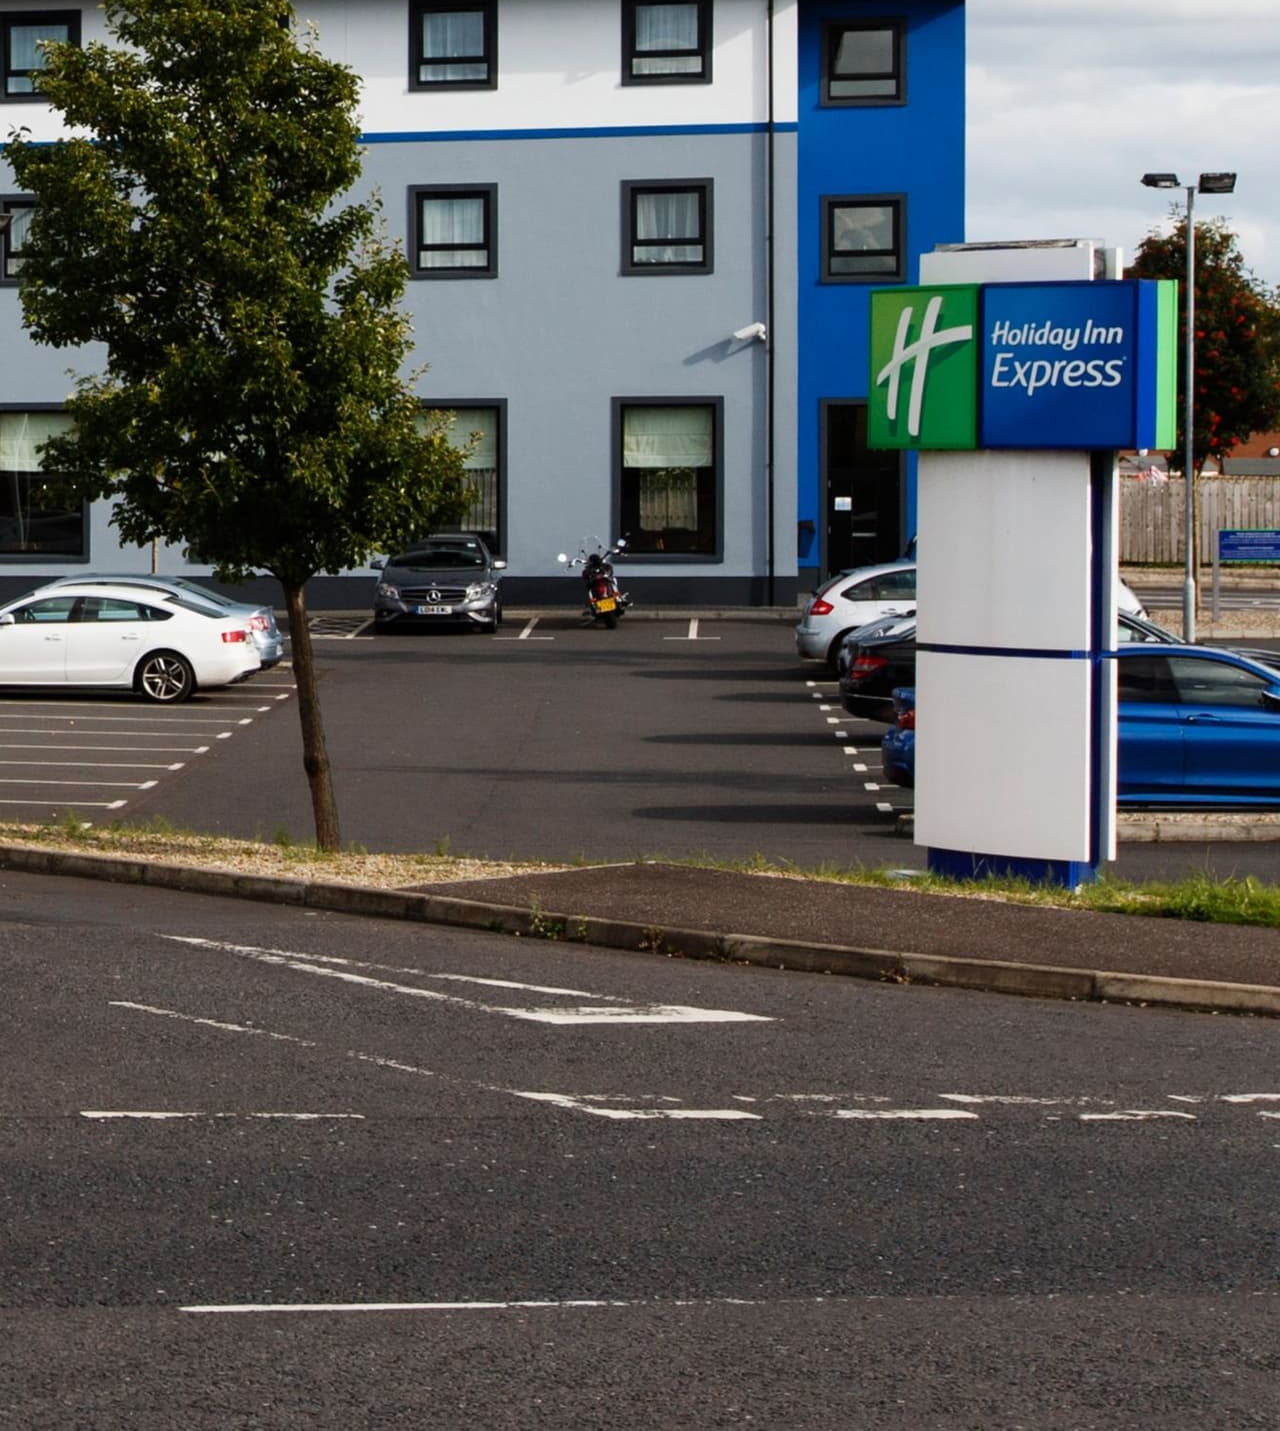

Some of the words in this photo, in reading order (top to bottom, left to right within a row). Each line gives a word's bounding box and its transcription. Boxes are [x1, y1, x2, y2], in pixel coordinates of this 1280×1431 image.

[991, 320, 1080, 351] Holiday
[1082, 319, 1123, 345] Inn
[876, 296, 973, 436] H
[991, 353, 1123, 396] Express
